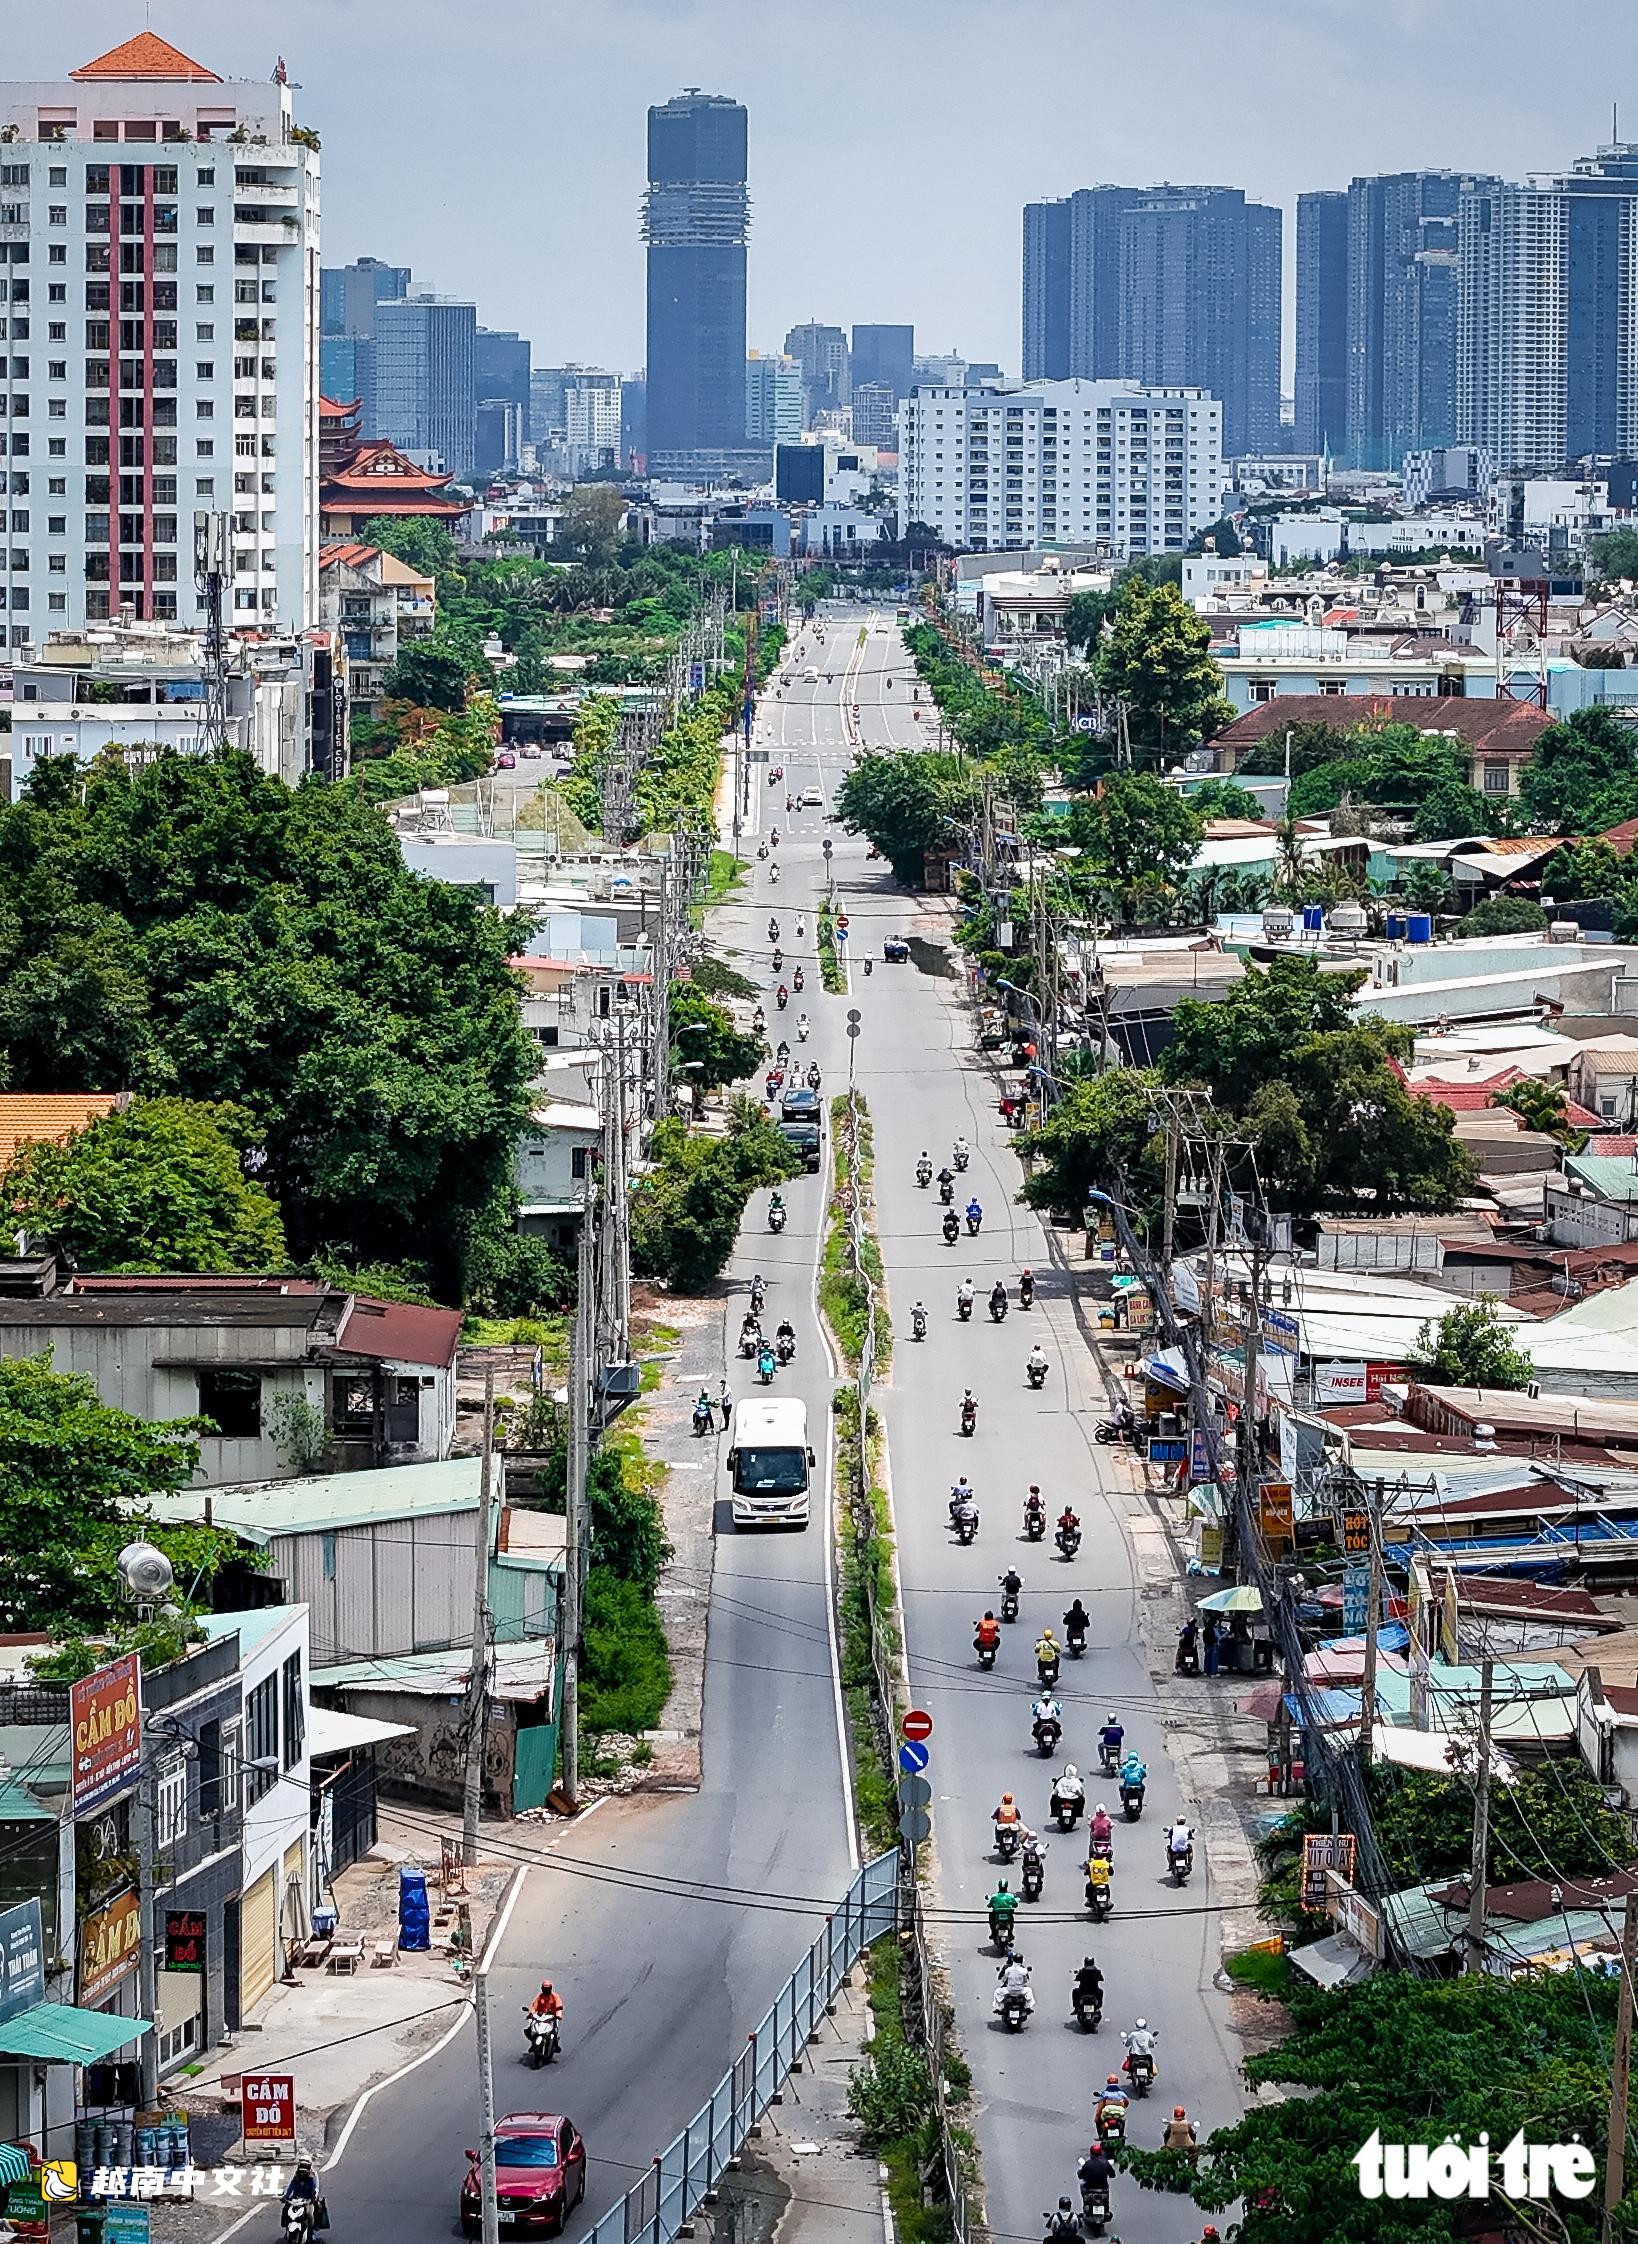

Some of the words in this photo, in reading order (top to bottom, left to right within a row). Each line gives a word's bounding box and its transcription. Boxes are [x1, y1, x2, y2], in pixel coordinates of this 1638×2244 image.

[334, 688, 343, 747] LOGISTICS
[1331, 1377, 1364, 1388] INSEE
[1345, 1532, 1368, 1549] TÓC
[76, 1699, 112, 1753] CẦM
[114, 1676, 137, 1732] ĐỒ
[247, 2077, 289, 2100] CẦM
[255, 2101, 281, 2123] ĐỒ
